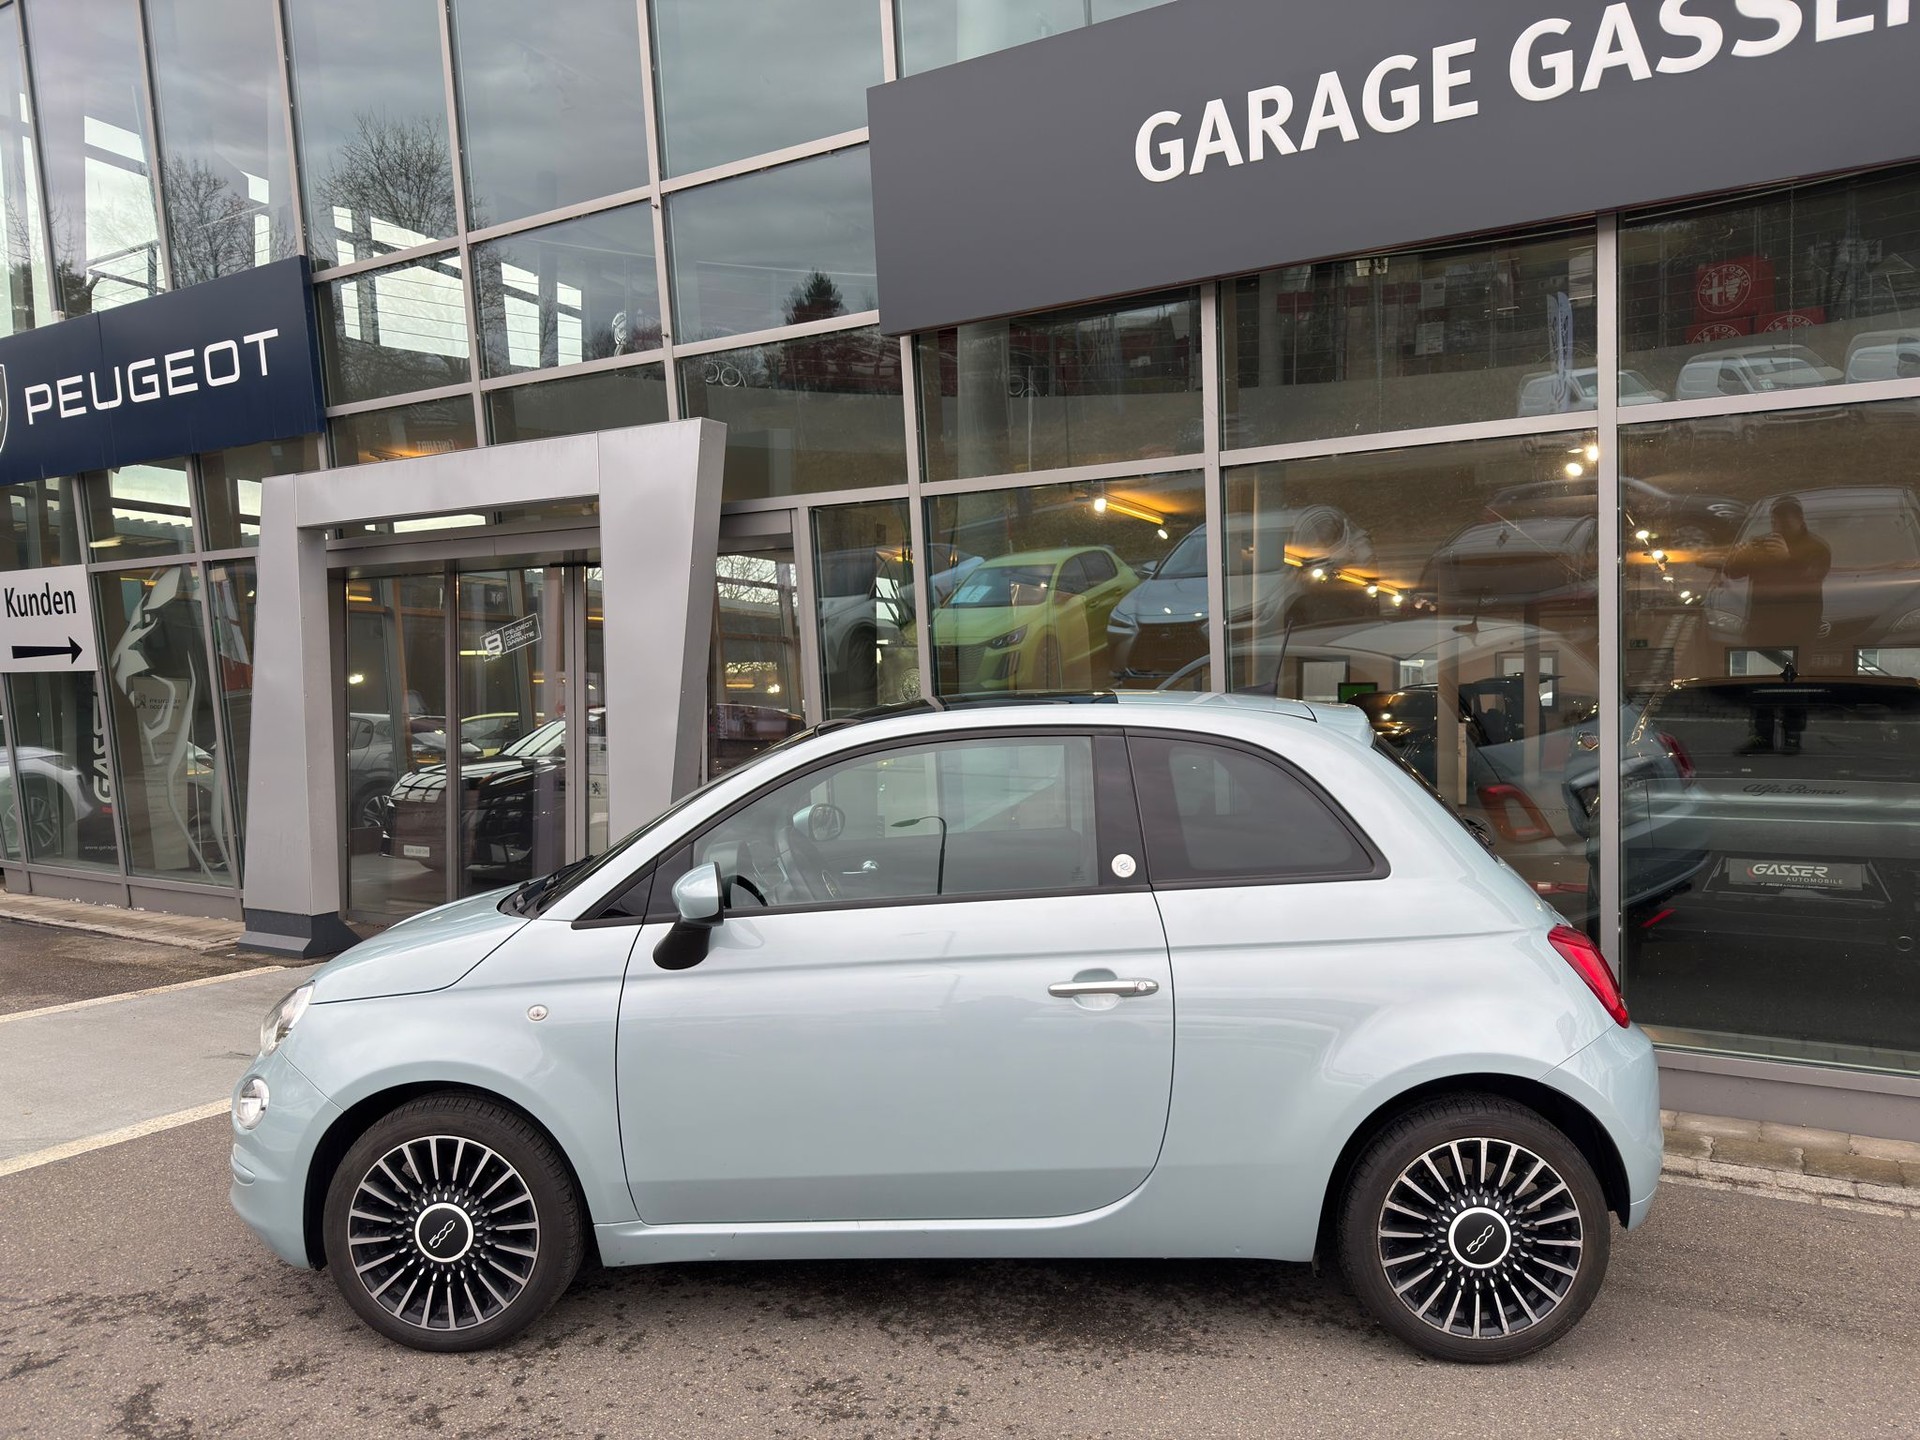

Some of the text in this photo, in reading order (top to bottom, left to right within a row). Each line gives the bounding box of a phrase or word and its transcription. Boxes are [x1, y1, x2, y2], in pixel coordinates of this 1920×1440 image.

[1134, 0, 1909, 183] GARAGE GASS
[24, 328, 279, 425] PEUGEOT
[4, 582, 77, 618] Kunden
[1742, 783, 1849, 797] Alfa Romeo
[1752, 863, 1829, 878] GASSER
[1785, 876, 1844, 885] AUTOMOBILE
